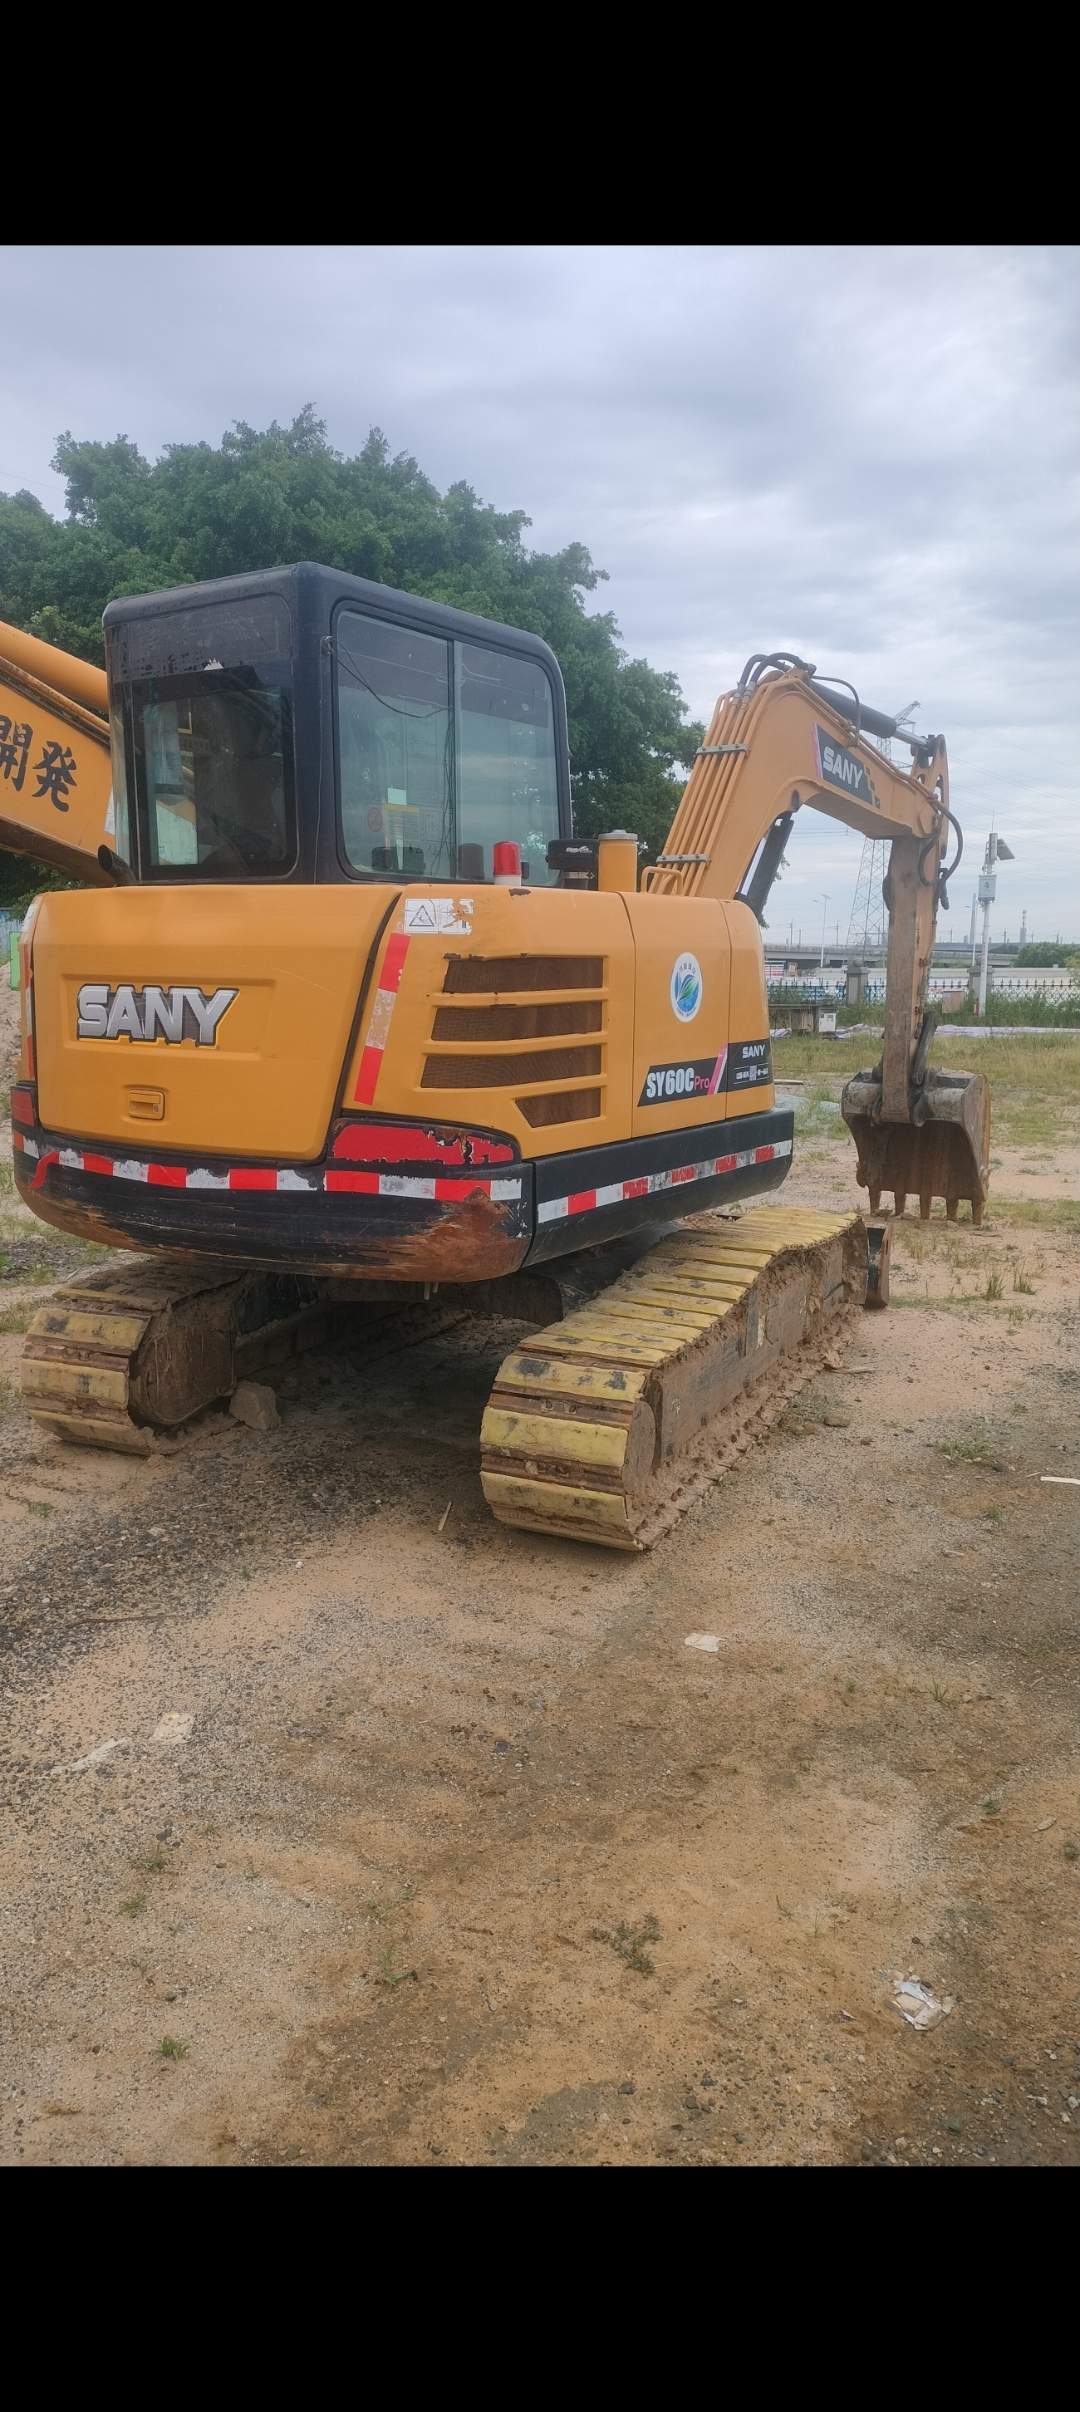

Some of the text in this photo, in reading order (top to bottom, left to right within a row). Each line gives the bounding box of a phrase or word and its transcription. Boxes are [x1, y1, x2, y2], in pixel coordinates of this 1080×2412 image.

[823, 746, 863, 788] SANY
[77, 983, 240, 1048] SANY
[742, 1044, 765, 1058] SANY
